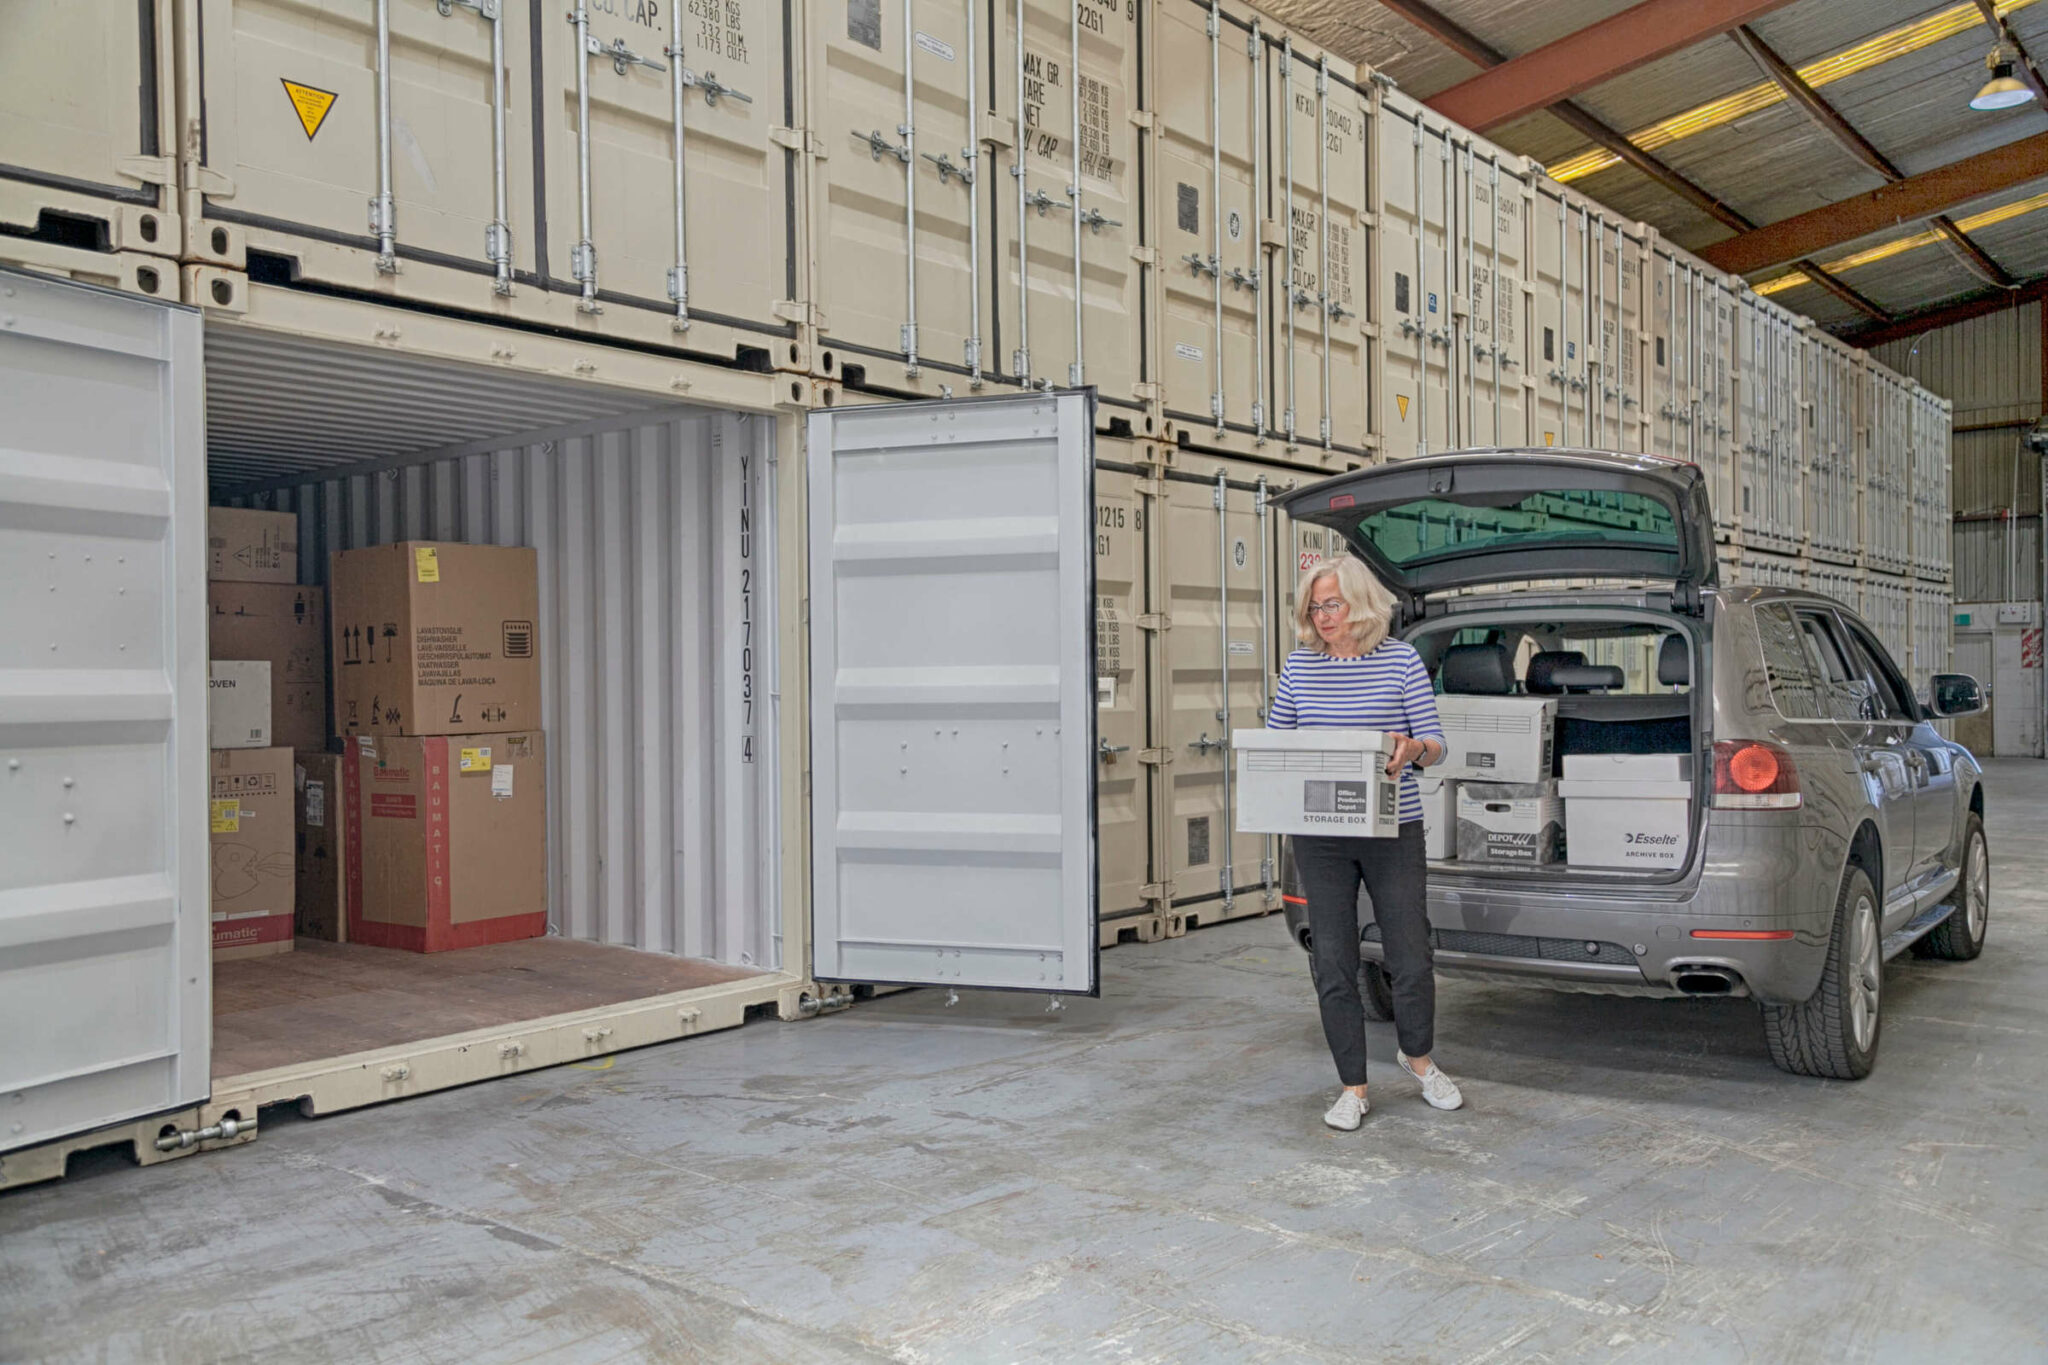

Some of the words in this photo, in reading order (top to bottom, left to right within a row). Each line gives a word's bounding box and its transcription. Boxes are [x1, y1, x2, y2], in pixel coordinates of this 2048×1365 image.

[725, 13, 741, 31] LBS
[1023, 76, 1045, 105] TARE
[1023, 102, 1041, 128] NET
[741, 455, 750, 558] YINU
[1135, 509, 1143, 531] 8
[1303, 530, 1323, 550] KINU
[742, 569, 751, 725] 217037
[209, 679, 236, 689] OVEN
[448, 678, 457, 686] DE
[1303, 815, 1346, 824] STORAGE
[1347, 816, 1367, 825] BOX
[1488, 833, 1514, 843] DEPOT
[1635, 832, 1677, 845] Esselte
[1490, 848, 1517, 857] Storage
[1625, 850, 1657, 858] ARCHIVE
[1659, 851, 1675, 859] BOX
[212, 926, 258, 941] umatic
